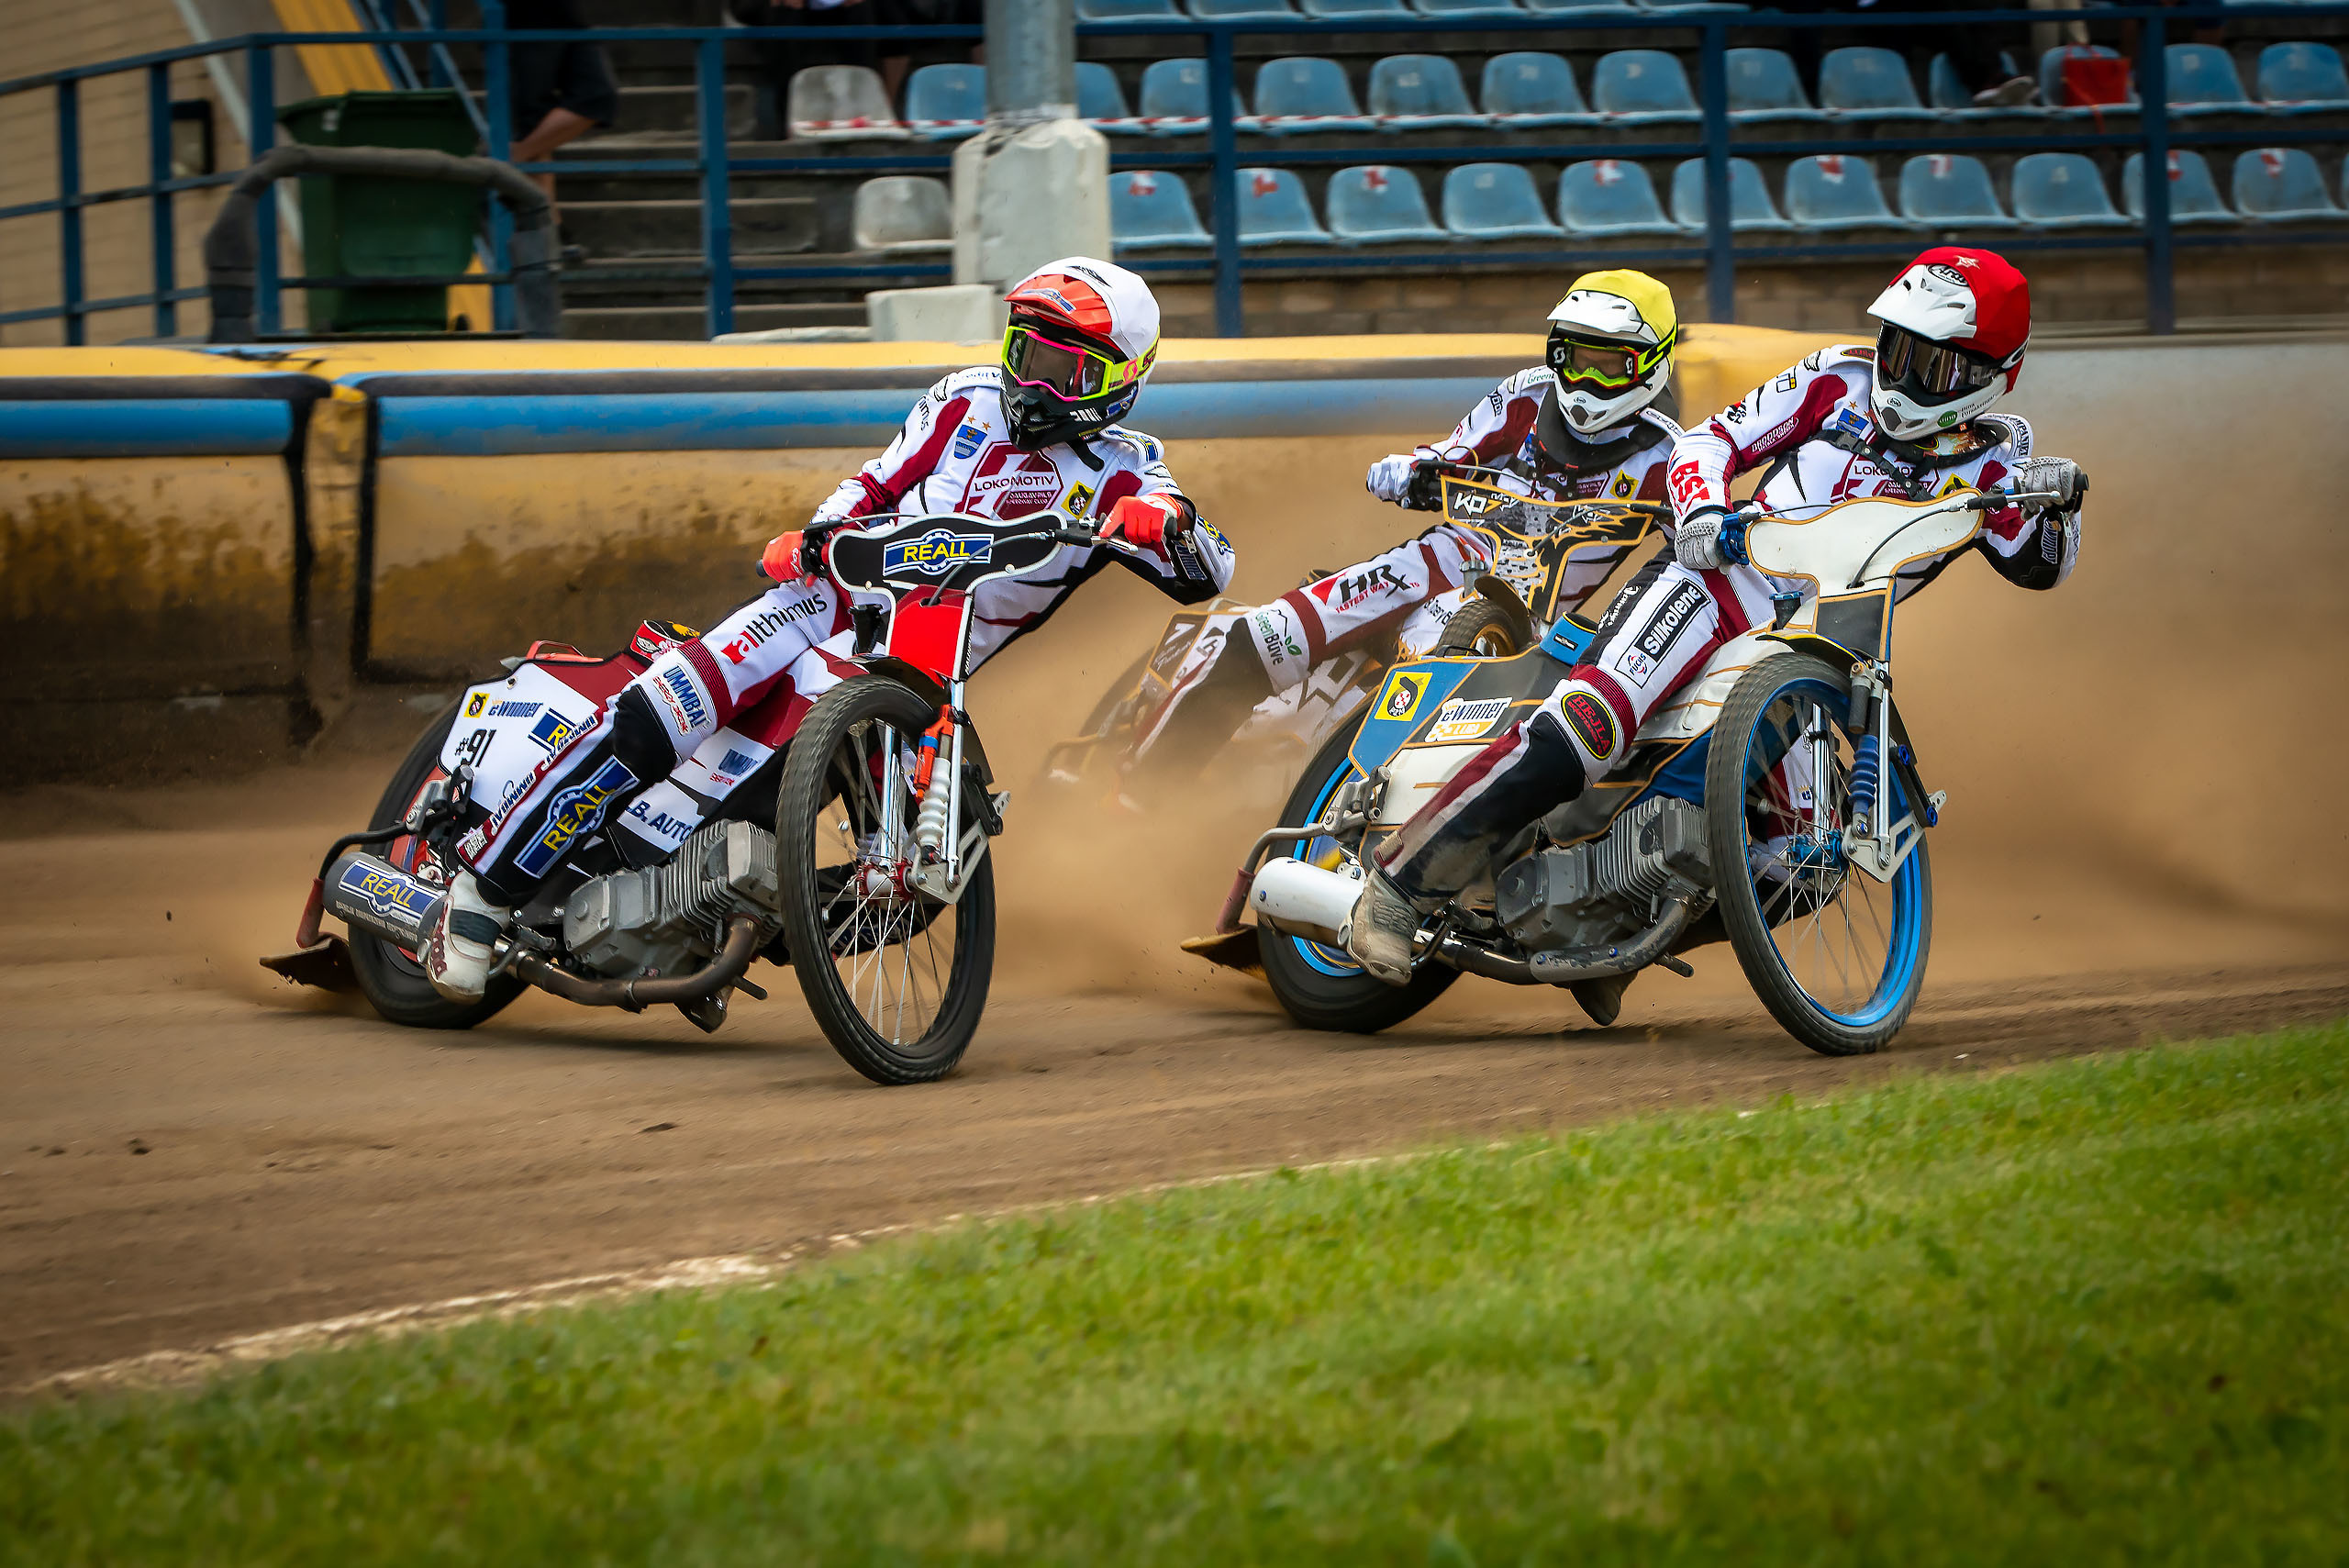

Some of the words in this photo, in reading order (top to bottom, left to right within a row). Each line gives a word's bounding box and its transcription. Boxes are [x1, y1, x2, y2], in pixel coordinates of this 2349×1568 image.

[974, 475, 1055, 492] LOKOMOTIV
[903, 540, 971, 562] REALL
[1643, 585, 1702, 655] Silkolene
[1441, 701, 1508, 721] eWinner
[1571, 693, 1610, 752] HEJLA
[542, 784, 617, 851] REALL
[360, 872, 417, 907] REALL
